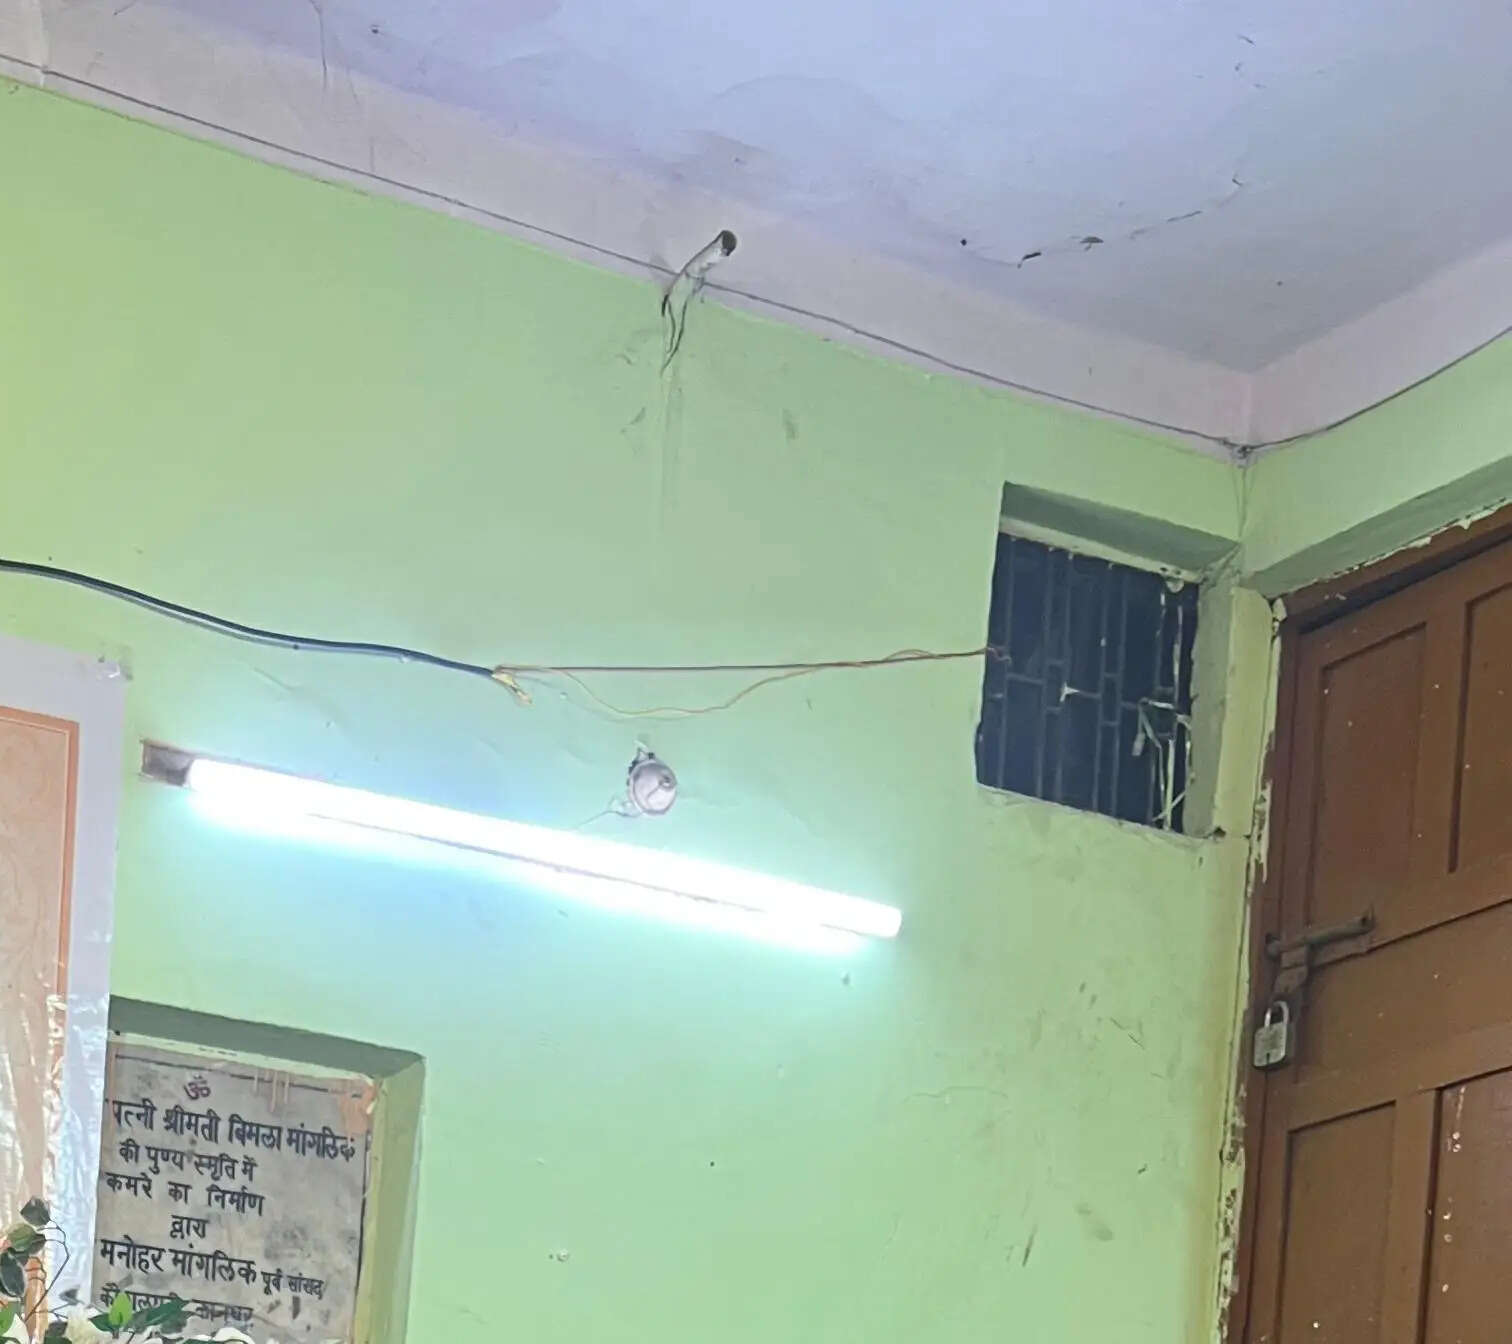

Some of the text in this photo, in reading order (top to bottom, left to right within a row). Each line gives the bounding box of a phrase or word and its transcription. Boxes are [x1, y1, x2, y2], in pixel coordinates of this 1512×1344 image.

[112, 1098, 156, 1131] पत्नी
[163, 1105, 221, 1144] श्रीमती
[119, 1138, 258, 1182] की पुण्य स्मृति में
[105, 1172, 265, 1217] कमरे का निर्माण
[170, 1214, 209, 1239] द्वारा
[100, 1235, 166, 1272] मनोहर
[168, 1243, 257, 1284] मांगलिक
